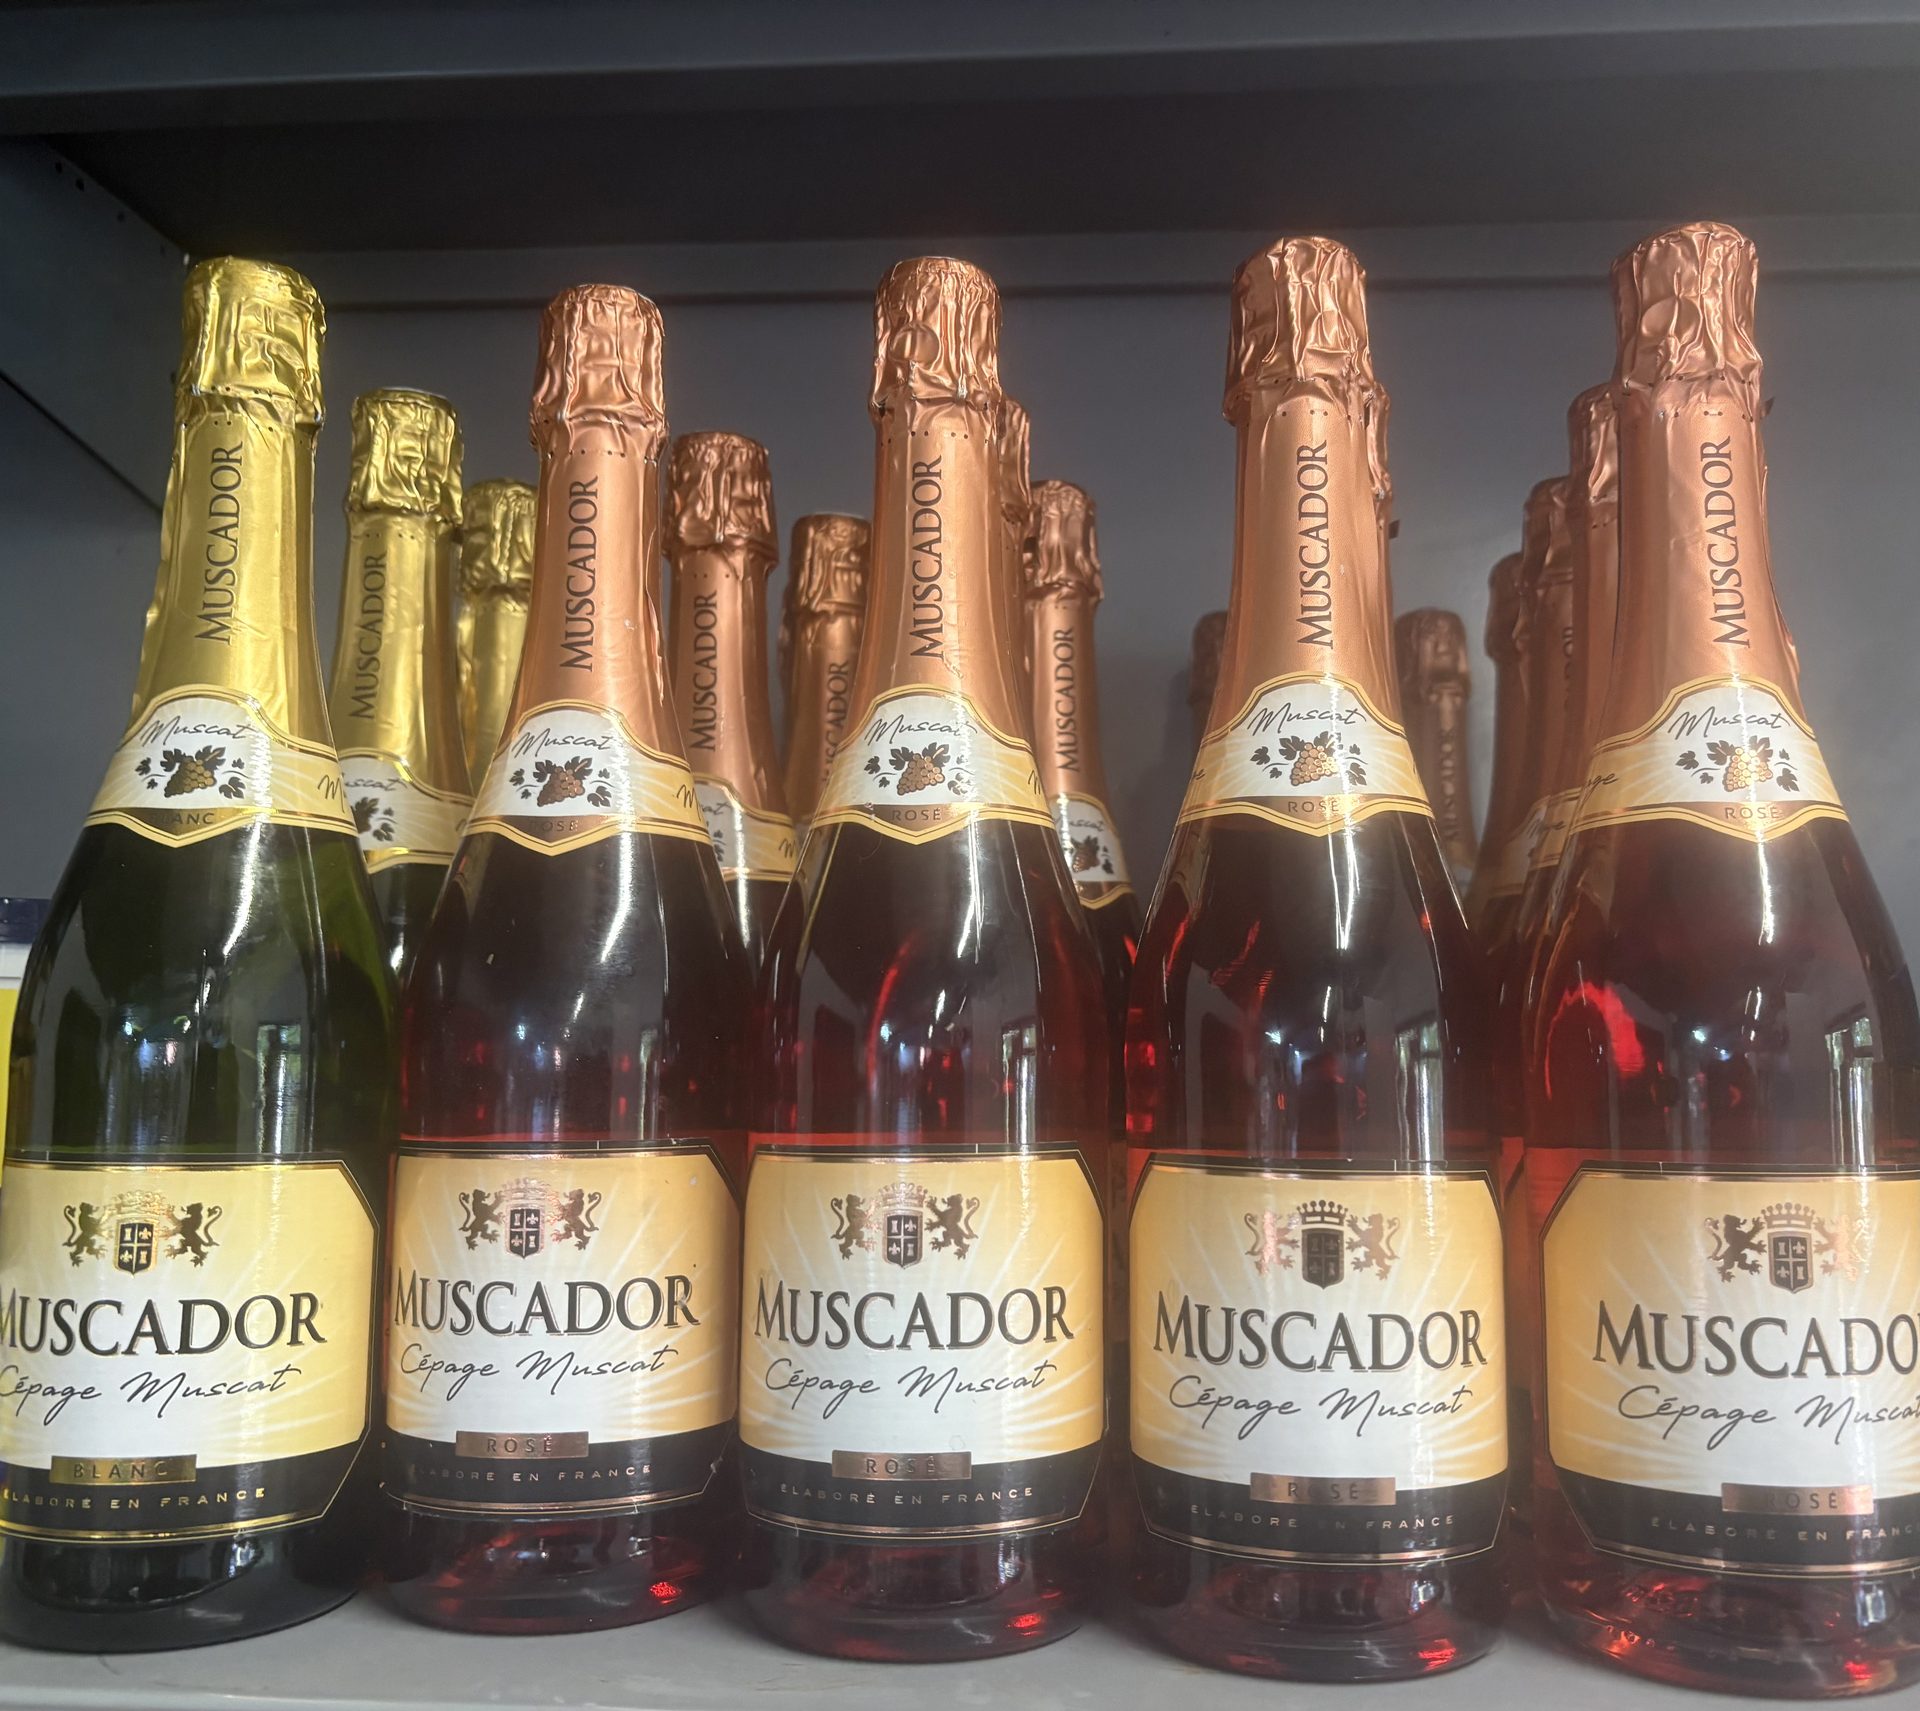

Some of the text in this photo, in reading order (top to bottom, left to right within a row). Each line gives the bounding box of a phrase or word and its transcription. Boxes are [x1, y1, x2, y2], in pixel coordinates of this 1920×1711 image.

[195, 441, 243, 646] MUSCADOR
[560, 475, 598, 673] MUSCADOR
[910, 454, 943, 660] MUSCADOR
[1297, 439, 1333, 650] MUSCADOR
[1700, 436, 1751, 649] MUSCADOR
[350, 549, 386, 720] MUSCADOR
[689, 589, 718, 753] MUSCADOR
[1053, 627, 1081, 773] MUSCADOR
[140, 715, 256, 747] Muscat
[511, 727, 612, 758] Muscat
[1247, 702, 1367, 736] Muscat
[1667, 705, 1792, 740] Muscat
[891, 808, 942, 821] ROSÉ
[0, 1287, 327, 1357] MUSCADOR
[394, 1266, 702, 1337] MUSCADOR
[754, 1275, 1075, 1351] MUSCADOR
[1153, 1289, 1488, 1373] MUSCADOR
[1592, 1299, 1920, 1379] MUSCADO
[0, 1364, 302, 1426] Cépage Muscat
[399, 1342, 679, 1402] Cépage Muscat
[764, 1357, 1058, 1420] Cépage Muscat
[1169, 1374, 1473, 1441] Cépage Muscat
[1617, 1384, 1777, 1451] Cépage
[73, 1460, 169, 1479] BLANC
[487, 1434, 553, 1454] ROSÉ
[512, 1472, 540, 1482] EN
[558, 1464, 652, 1481] FRANCE
[866, 1455, 937, 1475] ROSÉ
[110, 1499, 140, 1510] EN
[160, 1487, 266, 1508] FRANCE
[942, 1487, 1033, 1504] FRANCE
[1366, 1515, 1454, 1529] FRANCE
[1797, 1531, 1828, 1541] EN
[1846, 1524, 1920, 1541] FRANC
